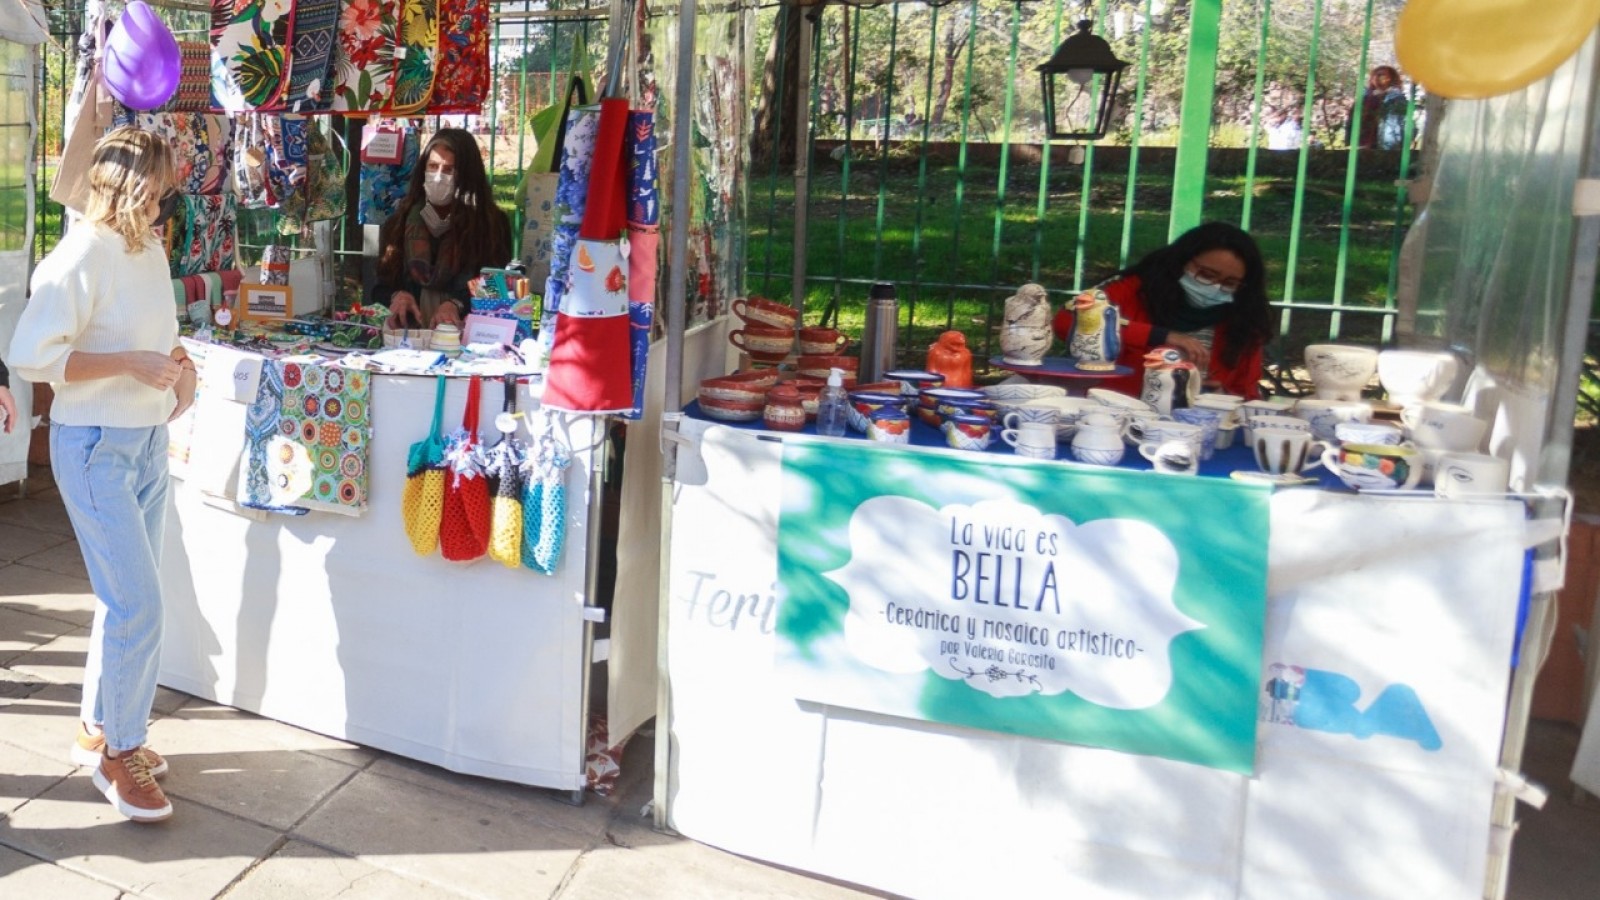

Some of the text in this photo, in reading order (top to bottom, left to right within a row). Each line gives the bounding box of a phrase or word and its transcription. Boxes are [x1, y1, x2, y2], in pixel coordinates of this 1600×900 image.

[950, 515, 973, 546] La
[1036, 531, 1058, 556] es
[951, 549, 1061, 615] BELLA
[966, 616, 977, 641] y
[983, 618, 1049, 647] mosaico
[939, 640, 961, 656] por
[964, 641, 1005, 663] Valeria
